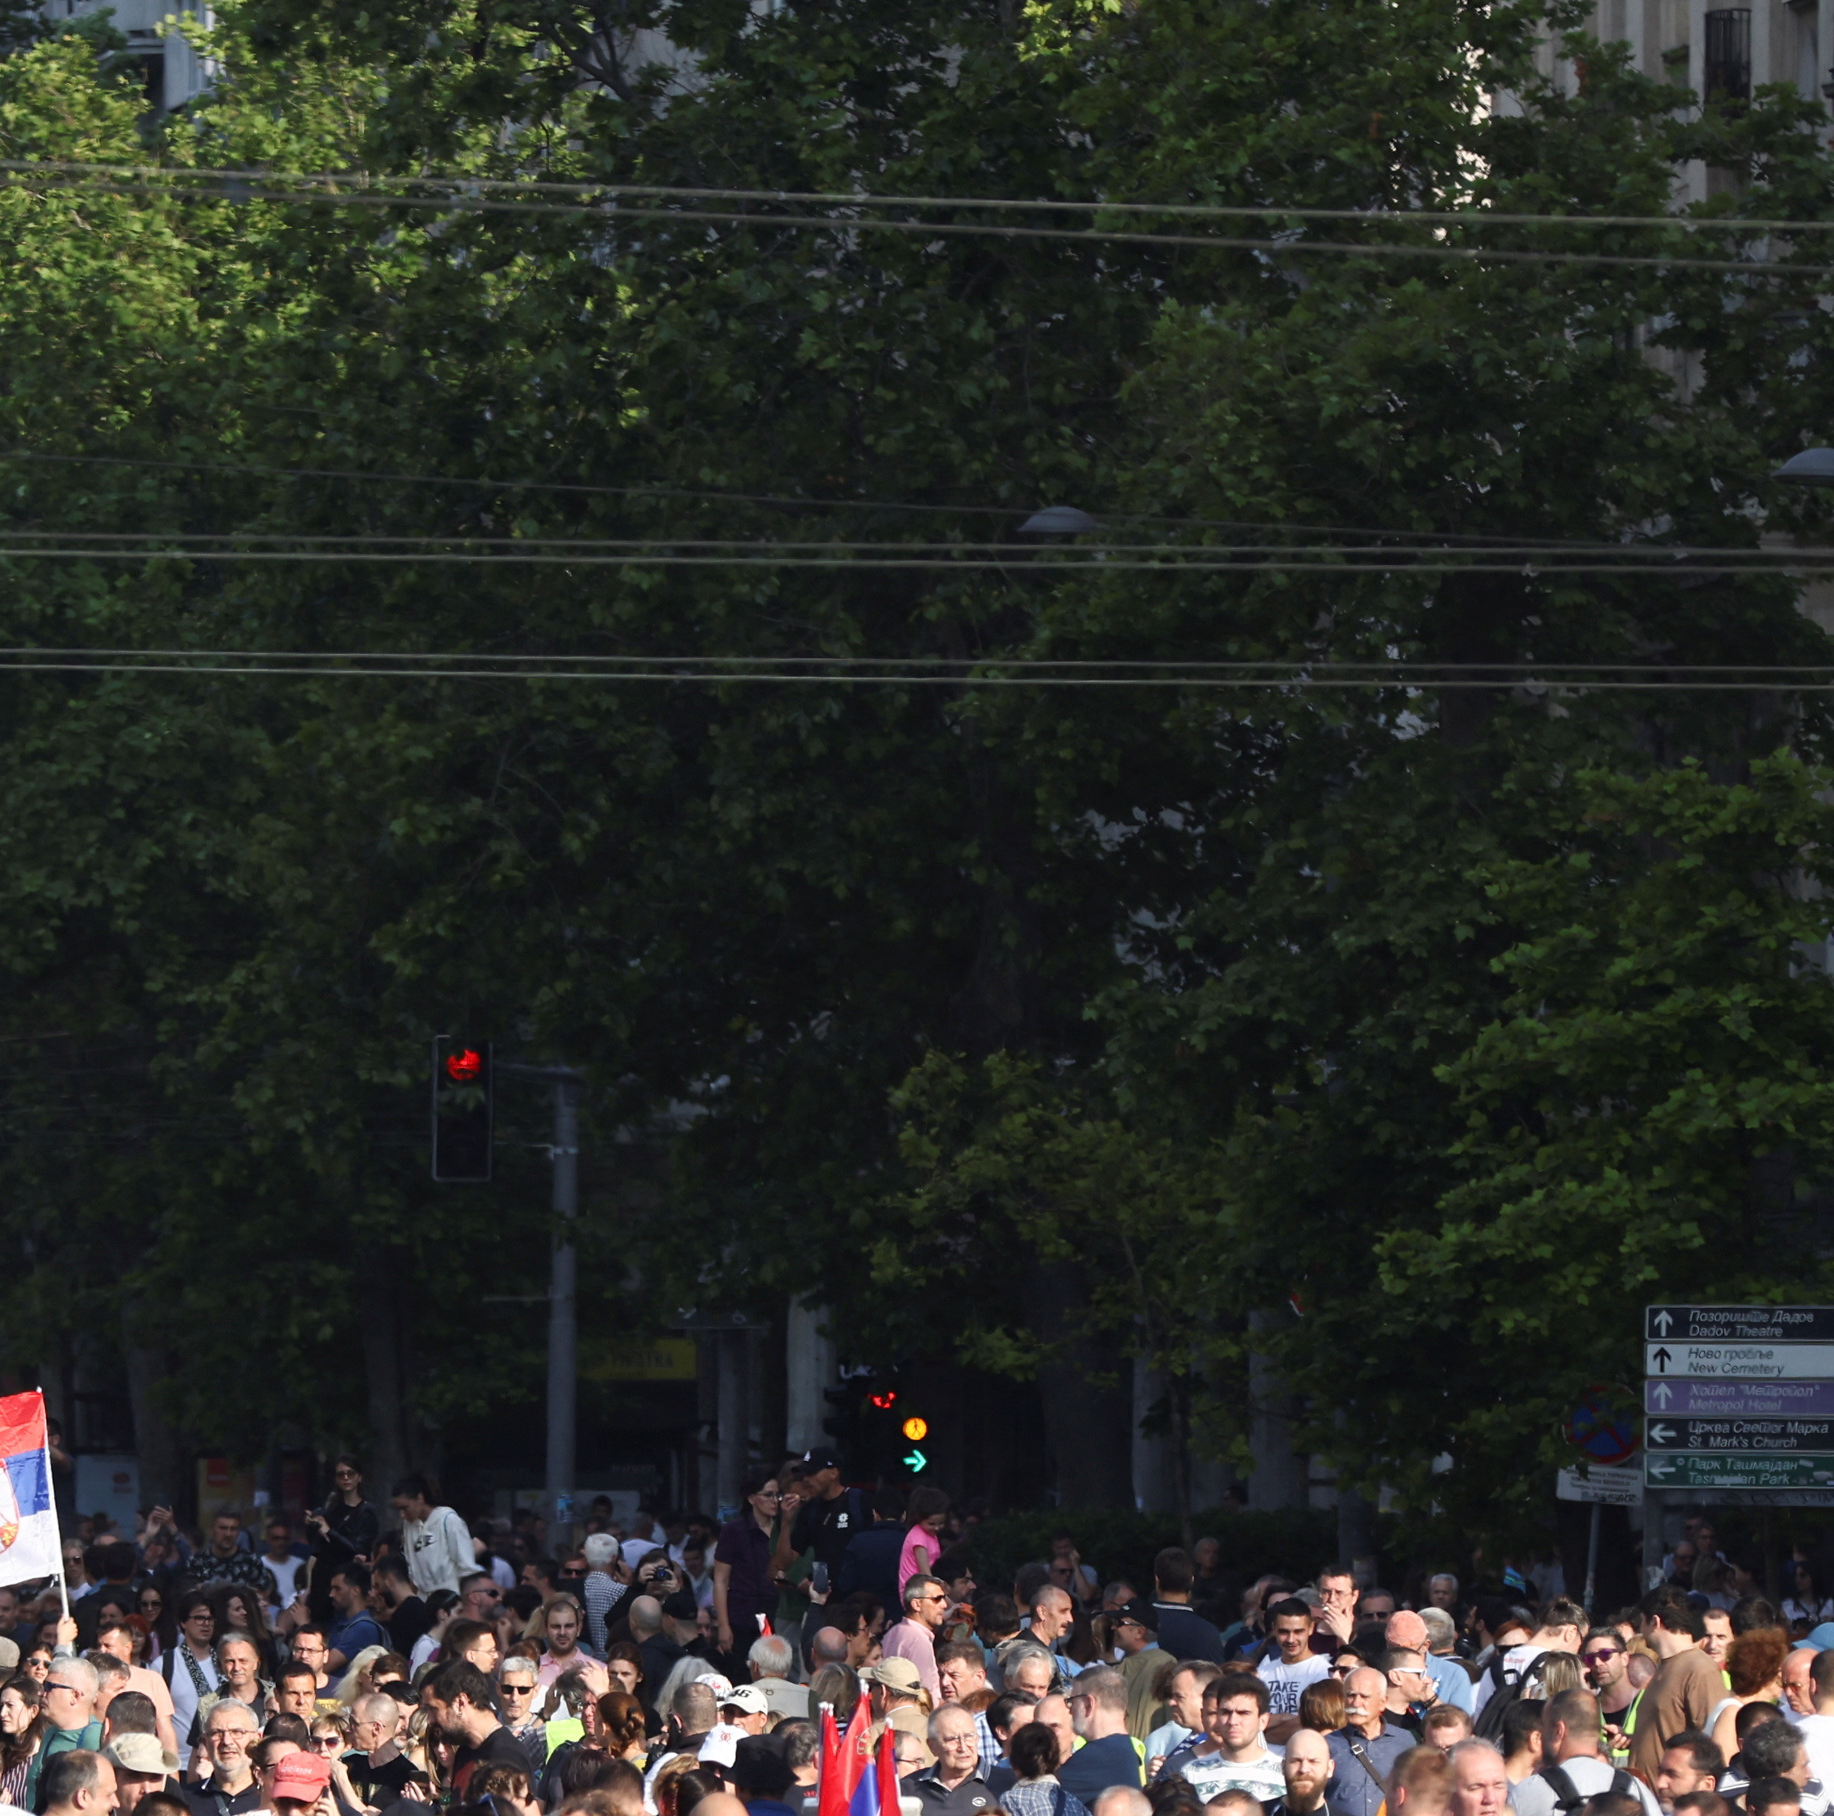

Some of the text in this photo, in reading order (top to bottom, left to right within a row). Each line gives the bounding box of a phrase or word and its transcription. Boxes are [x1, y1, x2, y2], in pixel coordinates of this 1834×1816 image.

[1689, 1310, 1814, 1324] Позориште Дадов
[1689, 1324, 1783, 1337] Dadov Theatre
[1688, 1347, 1774, 1362] Ново гробље
[1688, 1362, 1784, 1377] New Cemetery
[1689, 1384, 1735, 1396] Хотел
[1689, 1399, 1782, 1412] Metropol Hotel
[1688, 1421, 1829, 1436] Црква Светог Марка
[1709, 1436, 1749, 1448] Mark's
[1753, 1436, 1798, 1448] Church
[1688, 1457, 1798, 1472] Парк Ташмајдан
[1688, 1472, 1790, 1485] Tasman Park
[1268, 1680, 1301, 1693] TAKE
[1269, 1692, 1298, 1704] YOUR
